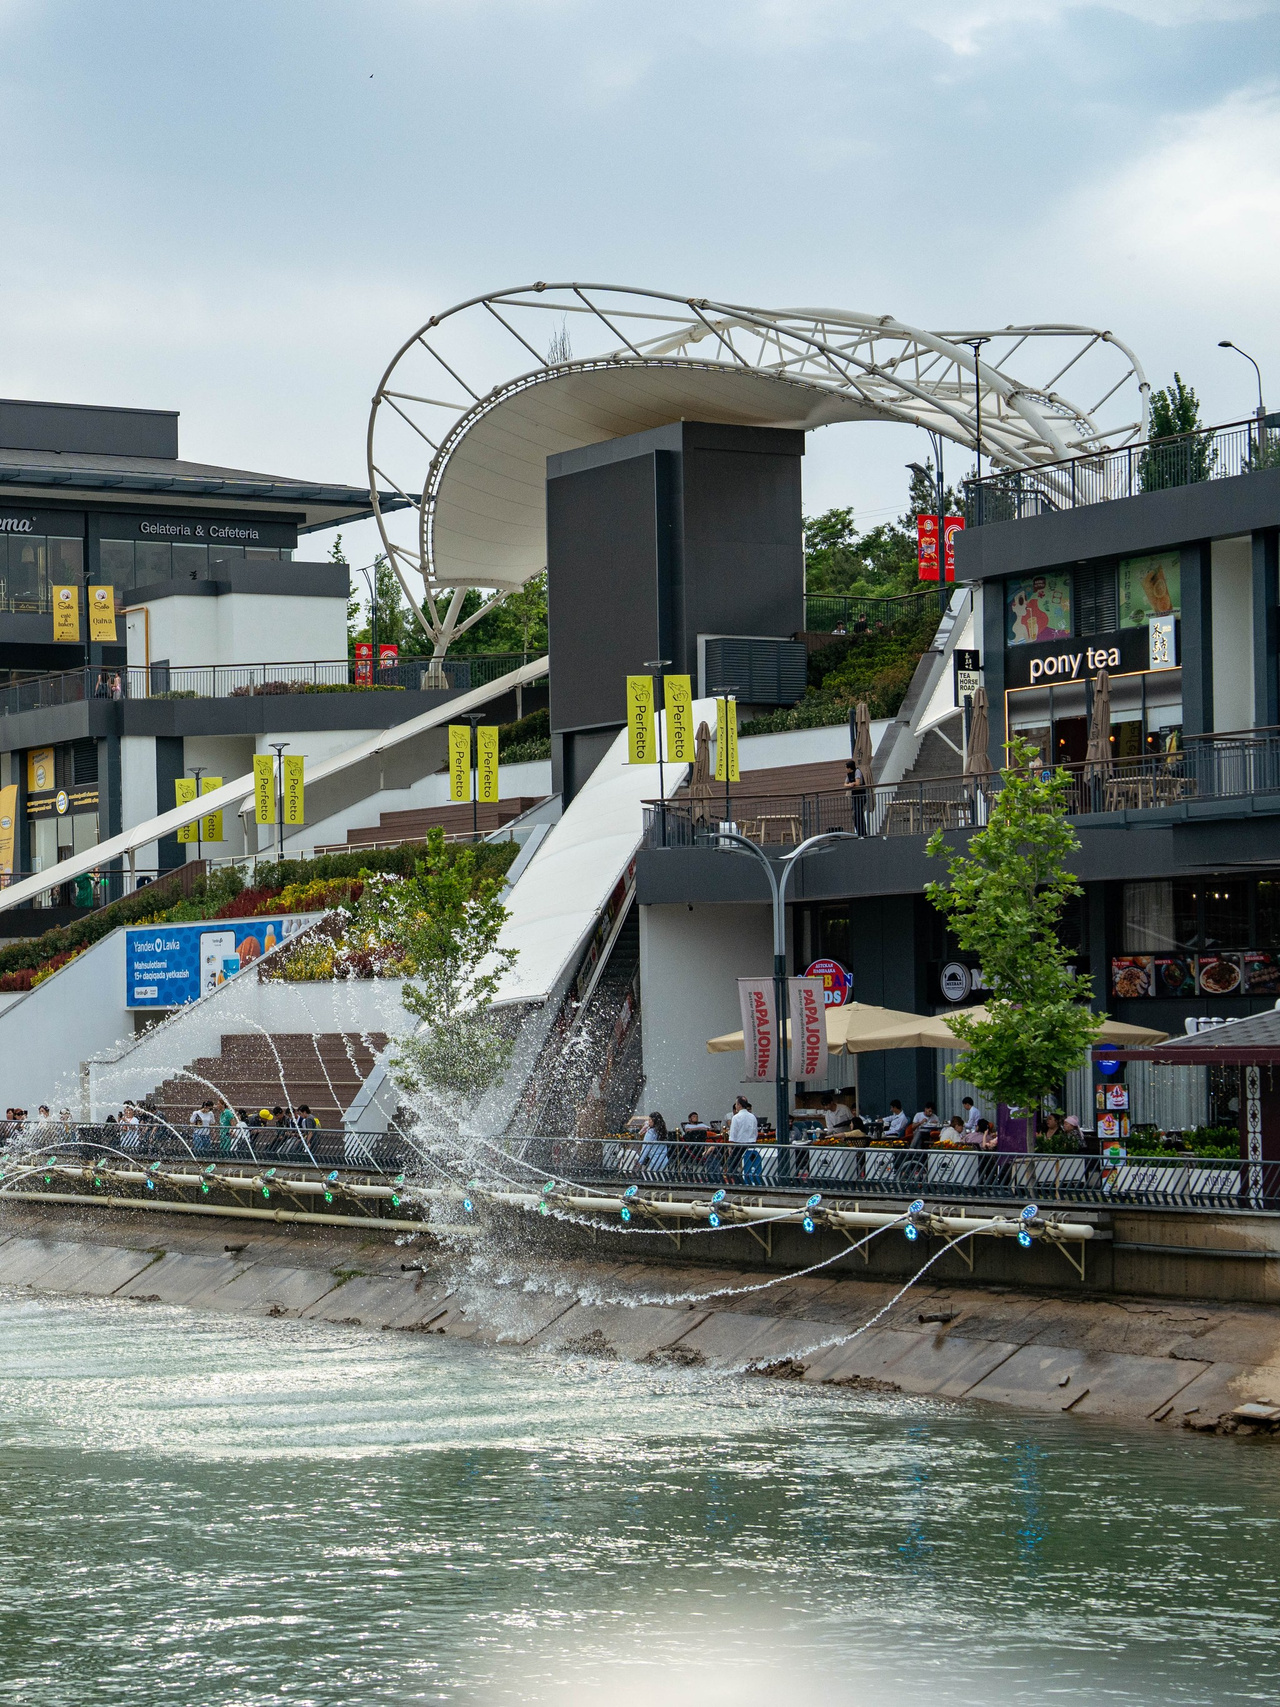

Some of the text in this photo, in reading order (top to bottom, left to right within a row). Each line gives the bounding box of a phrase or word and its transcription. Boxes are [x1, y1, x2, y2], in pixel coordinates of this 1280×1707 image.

[140, 521, 259, 539] Gelateria & Cafeteria
[1030, 647, 1121, 684] pony tea
[635, 705, 647, 759] Perfetto
[673, 705, 685, 758] Perfetto
[455, 751, 465, 798] Perfetto
[484, 751, 493, 798] Perfetto
[260, 778, 269, 821] Perfetto
[289, 779, 299, 821] Perfetto
[208, 814, 217, 838] fetto
[134, 939, 180, 952] Yandex Lavka
[134, 960, 167, 970] Mahsulotlarni
[134, 969, 190, 981] 15+ daqiqada yetkazish
[753, 991, 771, 1077] PAPA JOHNS
[803, 989, 820, 1075] PAPA JOHNS
